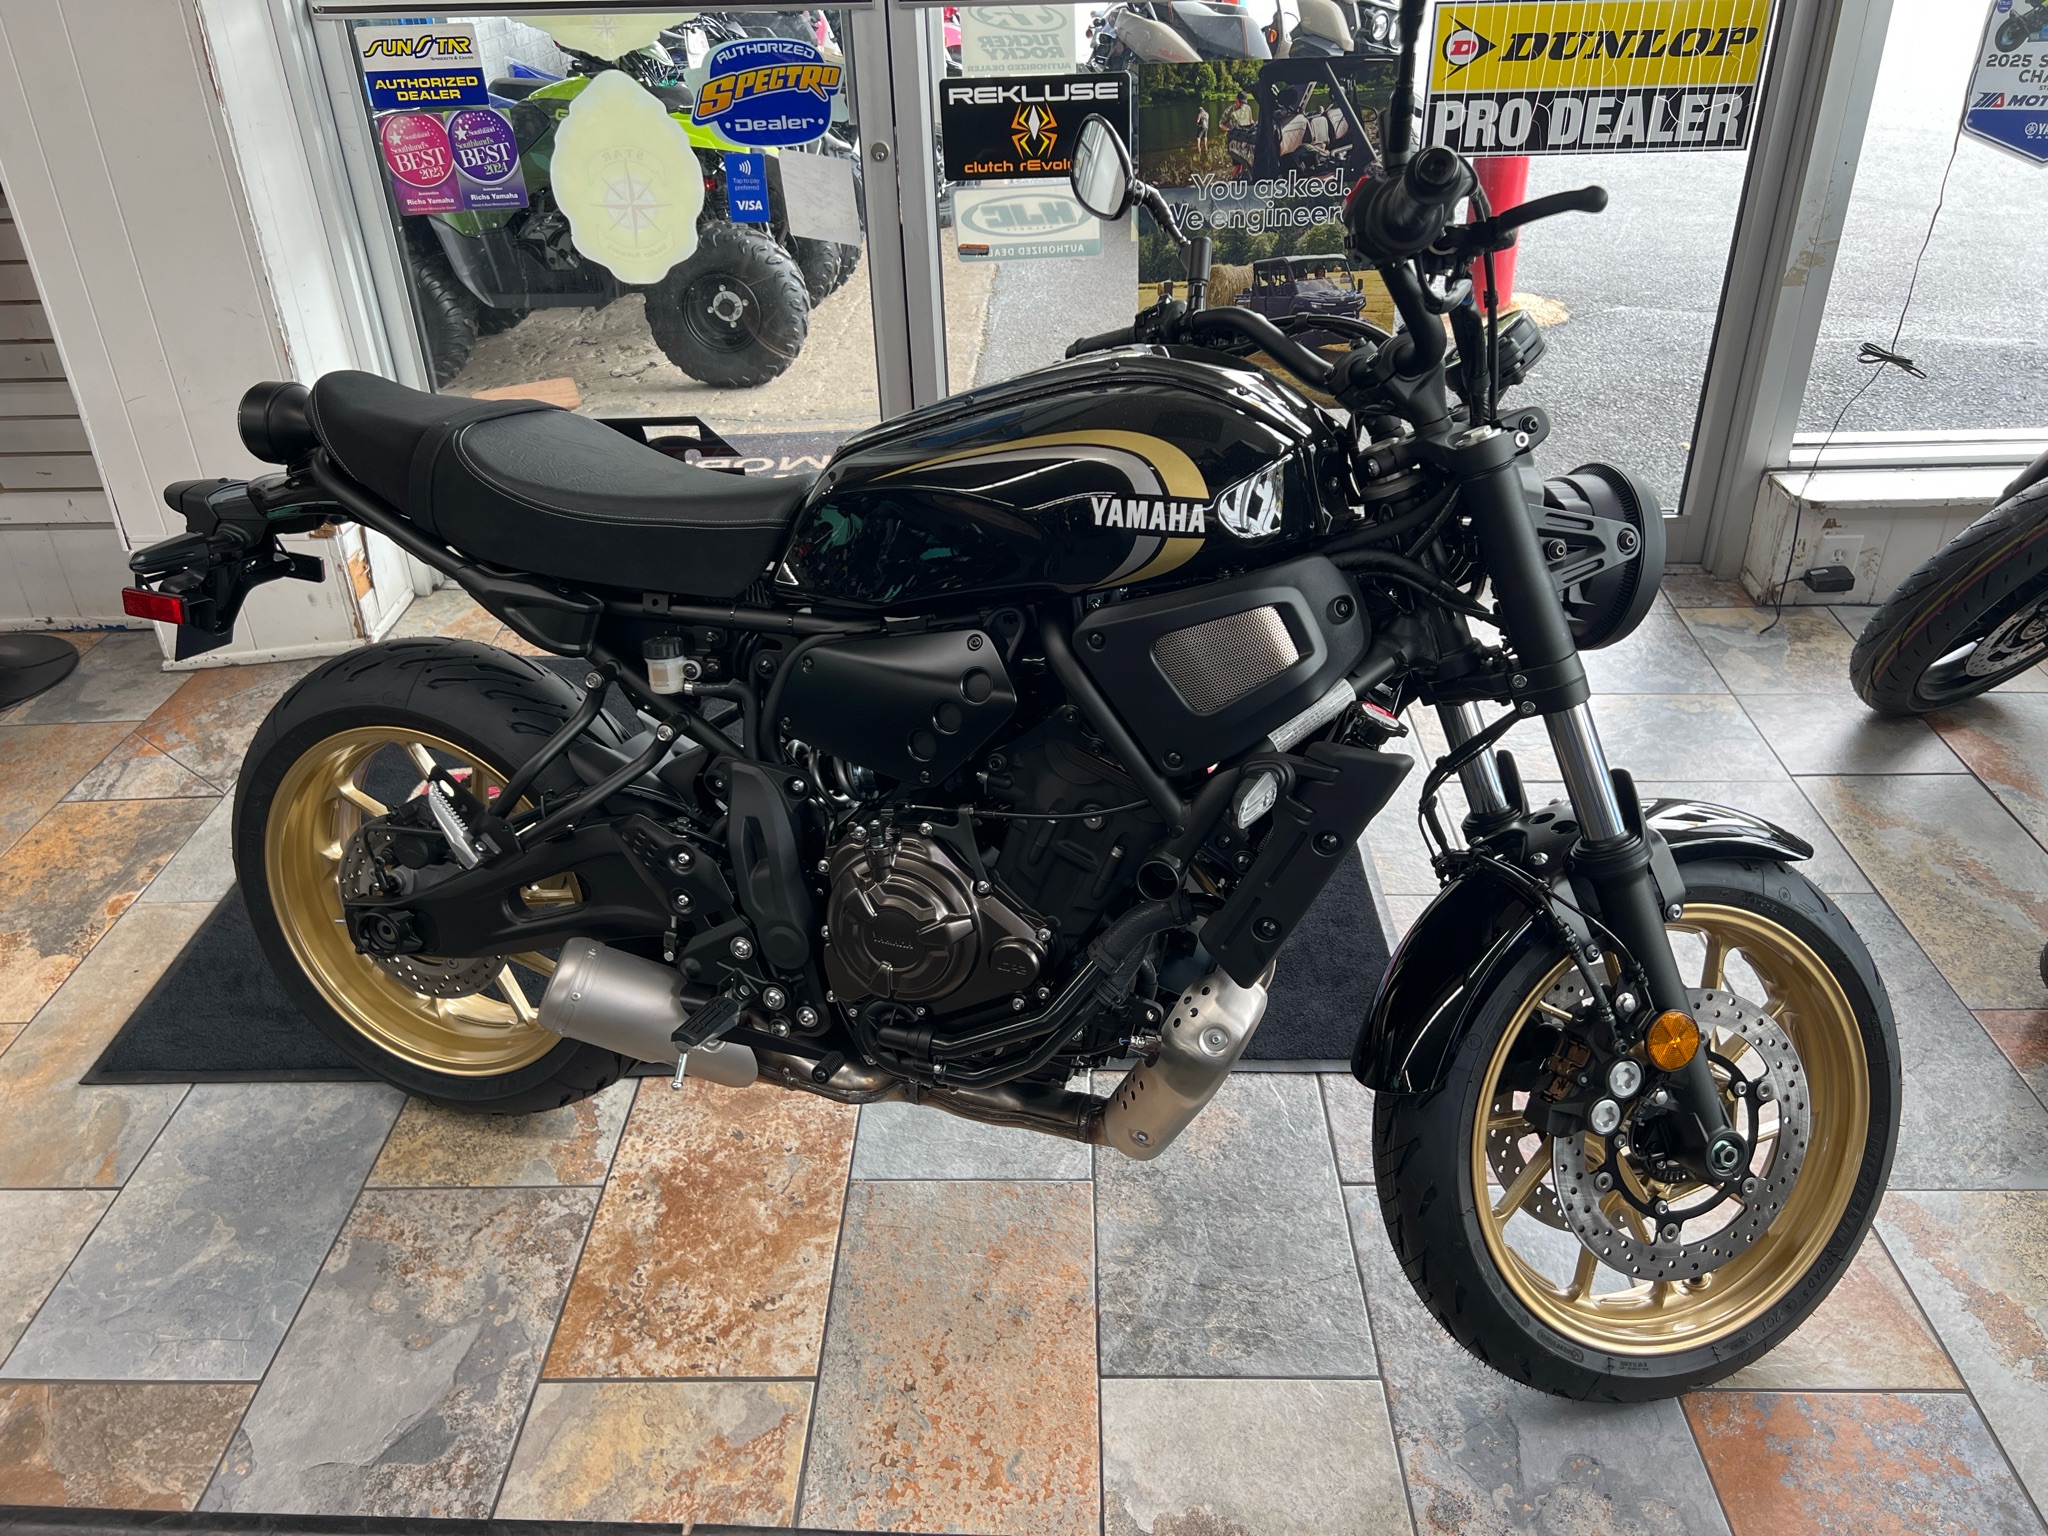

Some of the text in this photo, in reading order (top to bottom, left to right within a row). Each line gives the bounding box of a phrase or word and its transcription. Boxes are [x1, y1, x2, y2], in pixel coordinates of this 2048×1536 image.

[1498, 27, 1758, 62] DUNLOP
[716, 42, 816, 65] AUTHORIZED
[1985, 54, 2033, 68] 2025
[375, 76, 479, 90] AUTHORIZED
[396, 89, 462, 102] DEALER
[697, 65, 841, 116] SPECTRO
[948, 82, 1119, 106] REKLUSE
[734, 115, 815, 132] Dealer
[1432, 93, 1744, 149] PRO DEALER
[402, 131, 431, 141] Southland
[468, 126, 496, 136] Southland
[390, 141, 430, 154] Southland's
[455, 137, 495, 150] Southland's
[394, 146, 447, 173] BEST
[458, 142, 512, 169] BEST
[420, 166, 445, 180] 2023
[483, 162, 509, 176] 2024
[964, 160, 1014, 174] clutch
[1191, 168, 1351, 201] You asked.
[491, 192, 519, 200] Yamaha
[736, 200, 764, 211] VISA
[1210, 200, 1345, 236] engineer
[1090, 496, 1206, 533] YAMAHA
